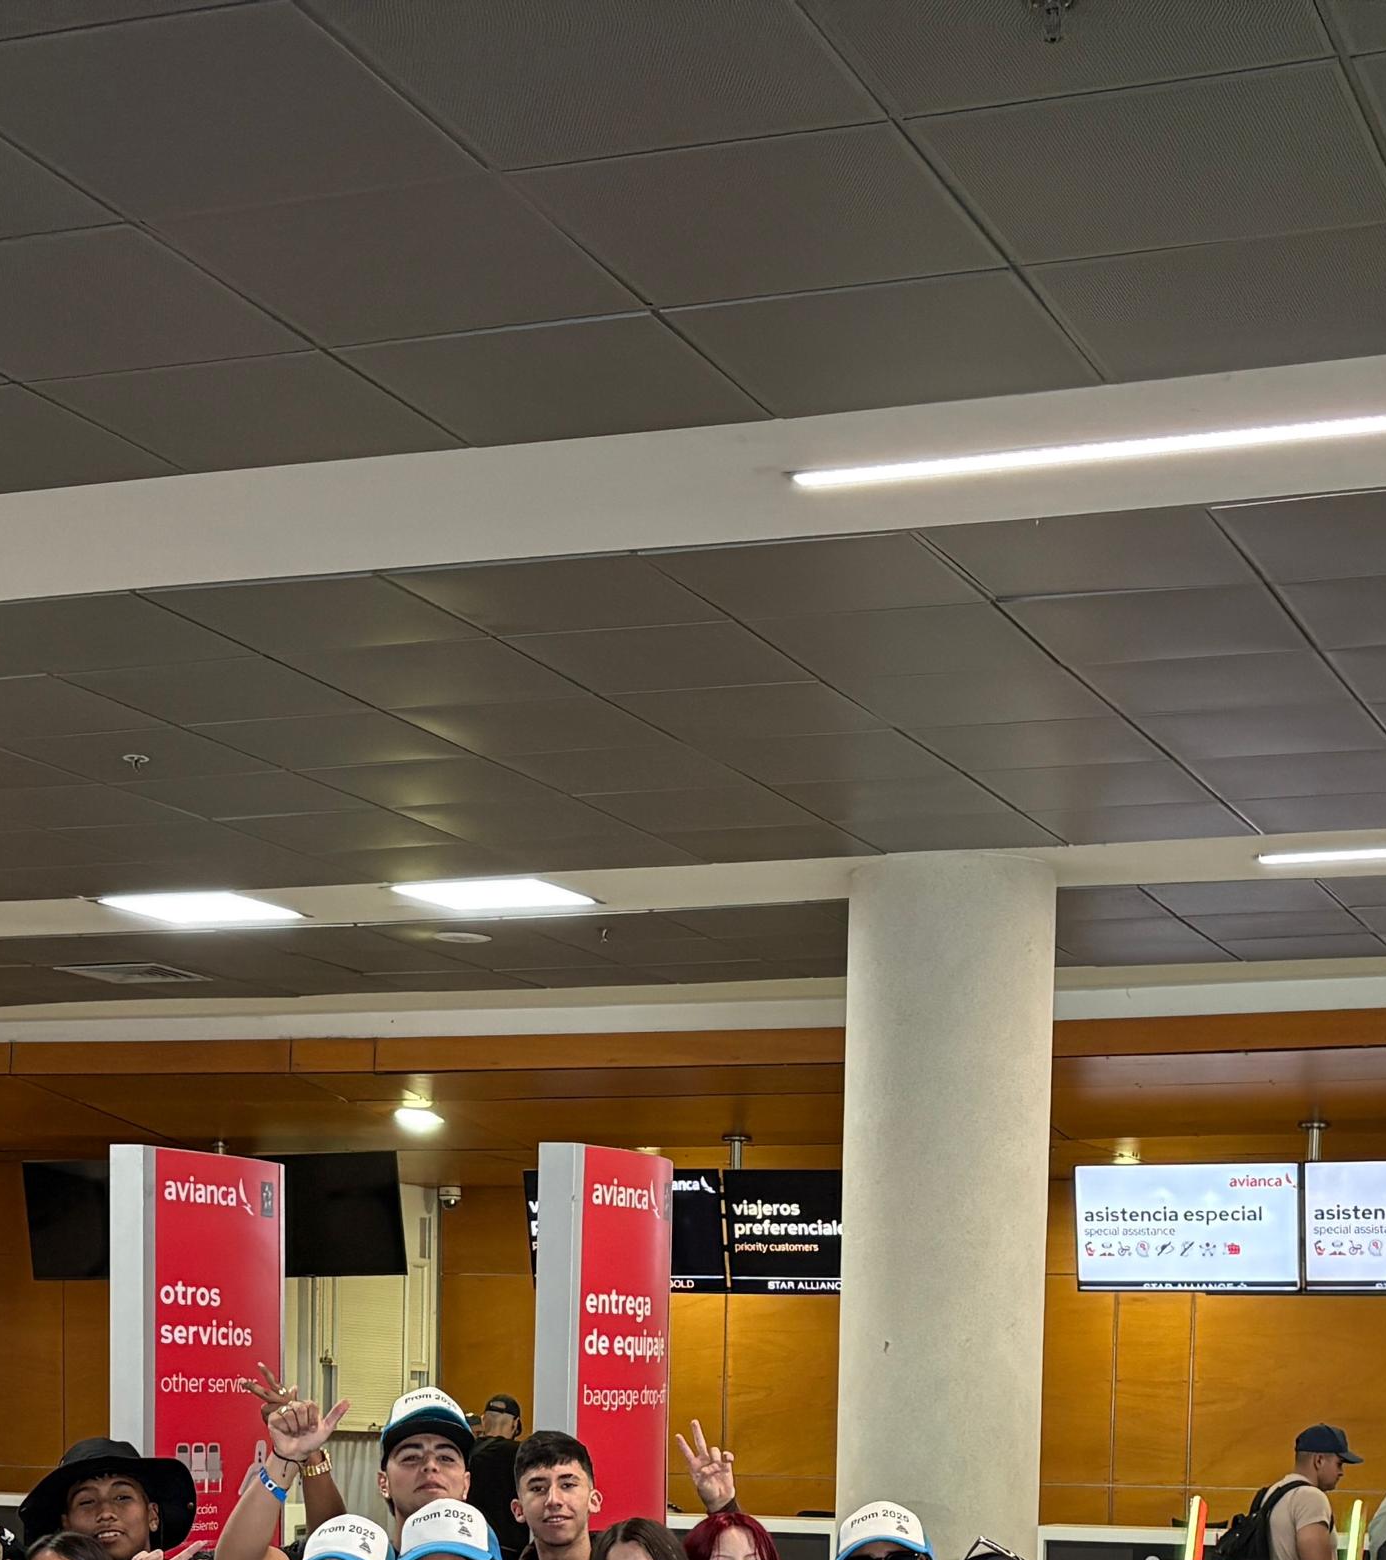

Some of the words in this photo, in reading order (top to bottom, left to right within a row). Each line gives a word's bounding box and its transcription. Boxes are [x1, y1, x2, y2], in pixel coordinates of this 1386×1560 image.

[1229, 1172, 1283, 1188] avianca
[164, 1176, 237, 1207] avianca
[592, 1178, 649, 1210] avianca
[732, 1200, 800, 1219] viajeros
[1084, 1206, 1178, 1223] asistencia
[1183, 1205, 1262, 1226] especial
[1084, 1226, 1119, 1238] special
[1123, 1226, 1175, 1237] assistance
[1314, 1223, 1350, 1236] special
[735, 1242, 768, 1253] priority
[770, 1242, 819, 1252] customers
[160, 1281, 221, 1307] otros
[767, 1281, 795, 1290] STAR
[585, 1290, 651, 1322] entrega
[160, 1320, 252, 1346] servicios
[584, 1329, 609, 1356] de
[614, 1329, 664, 1363] equipaje
[161, 1373, 205, 1393] other
[404, 1393, 432, 1404] Prom
[583, 1384, 639, 1411] baggage
[412, 1510, 441, 1526] Prom
[445, 1509, 474, 1523] 2025
[850, 1512, 879, 1528] Prom
[882, 1509, 910, 1523] 2025
[318, 1524, 345, 1537] Prom
[348, 1524, 376, 1540] 2025
